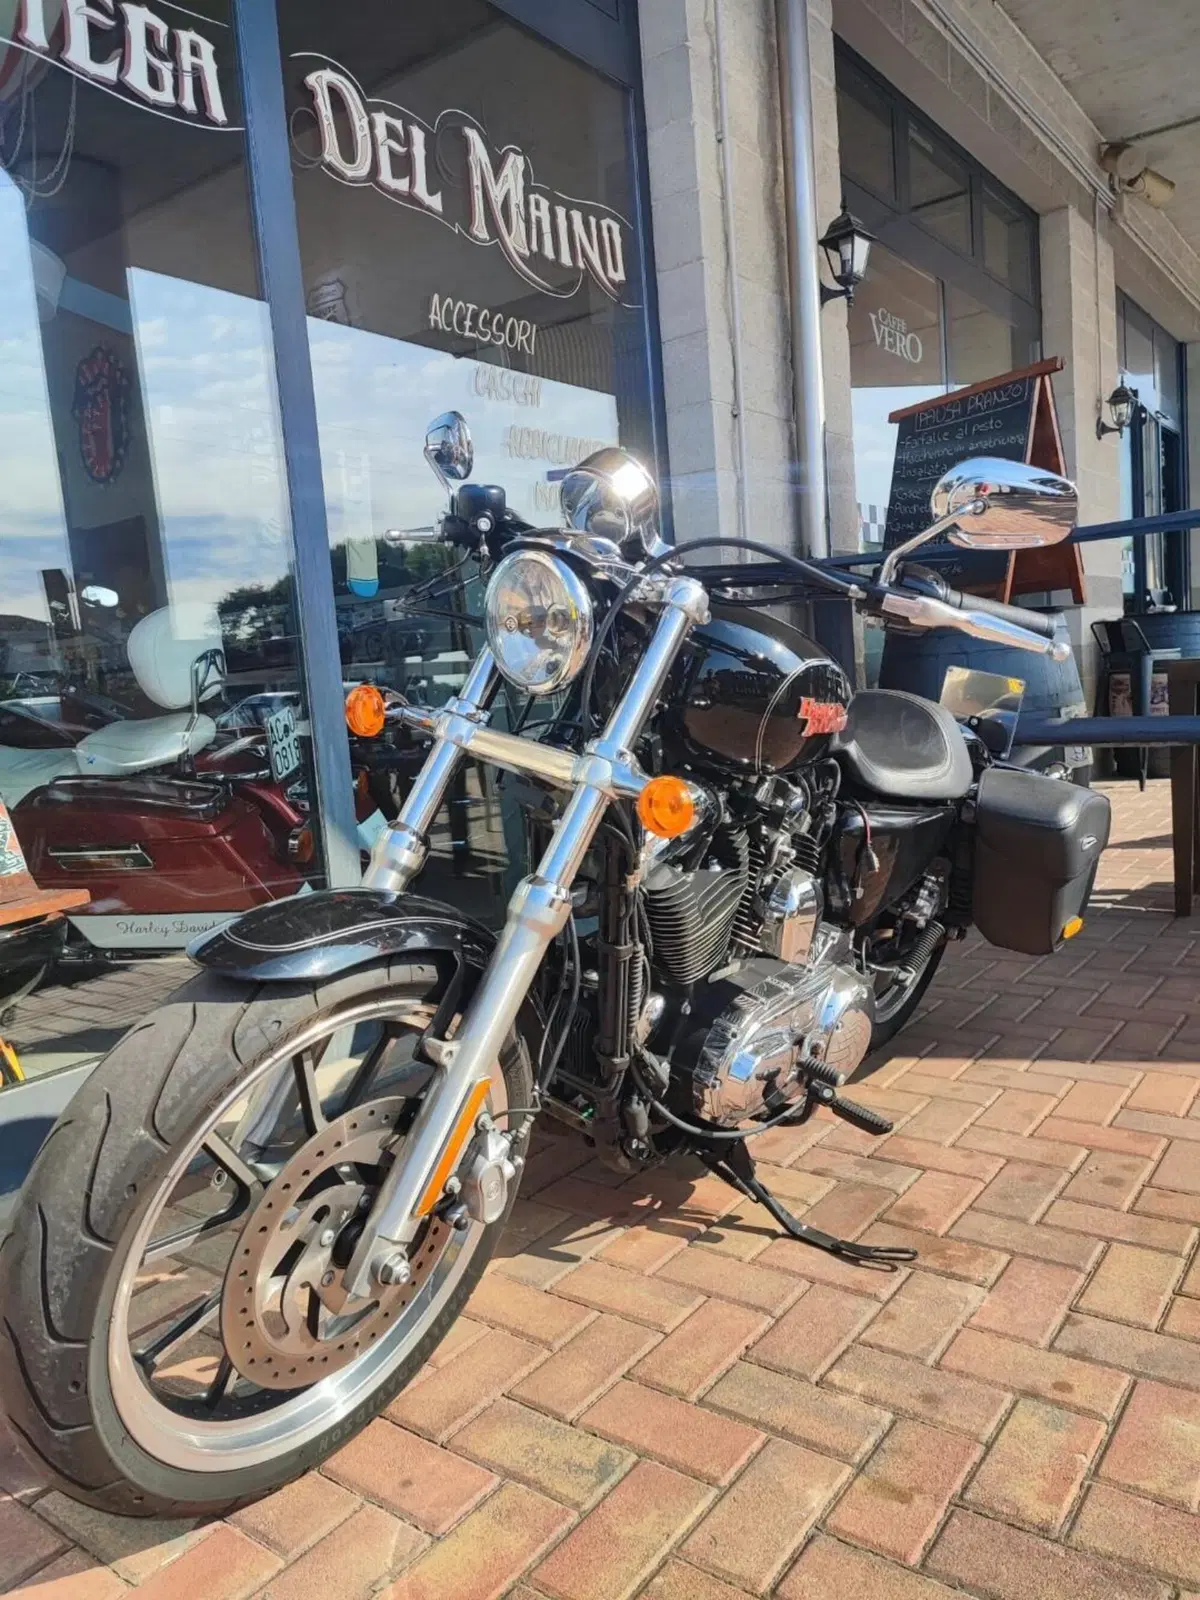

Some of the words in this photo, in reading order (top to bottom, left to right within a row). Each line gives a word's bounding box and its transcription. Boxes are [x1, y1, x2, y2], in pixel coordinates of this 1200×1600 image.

[428, 292, 538, 356] ACCESSORI
[868, 311, 923, 364] VERO
[116, 921, 170, 938] Harley
